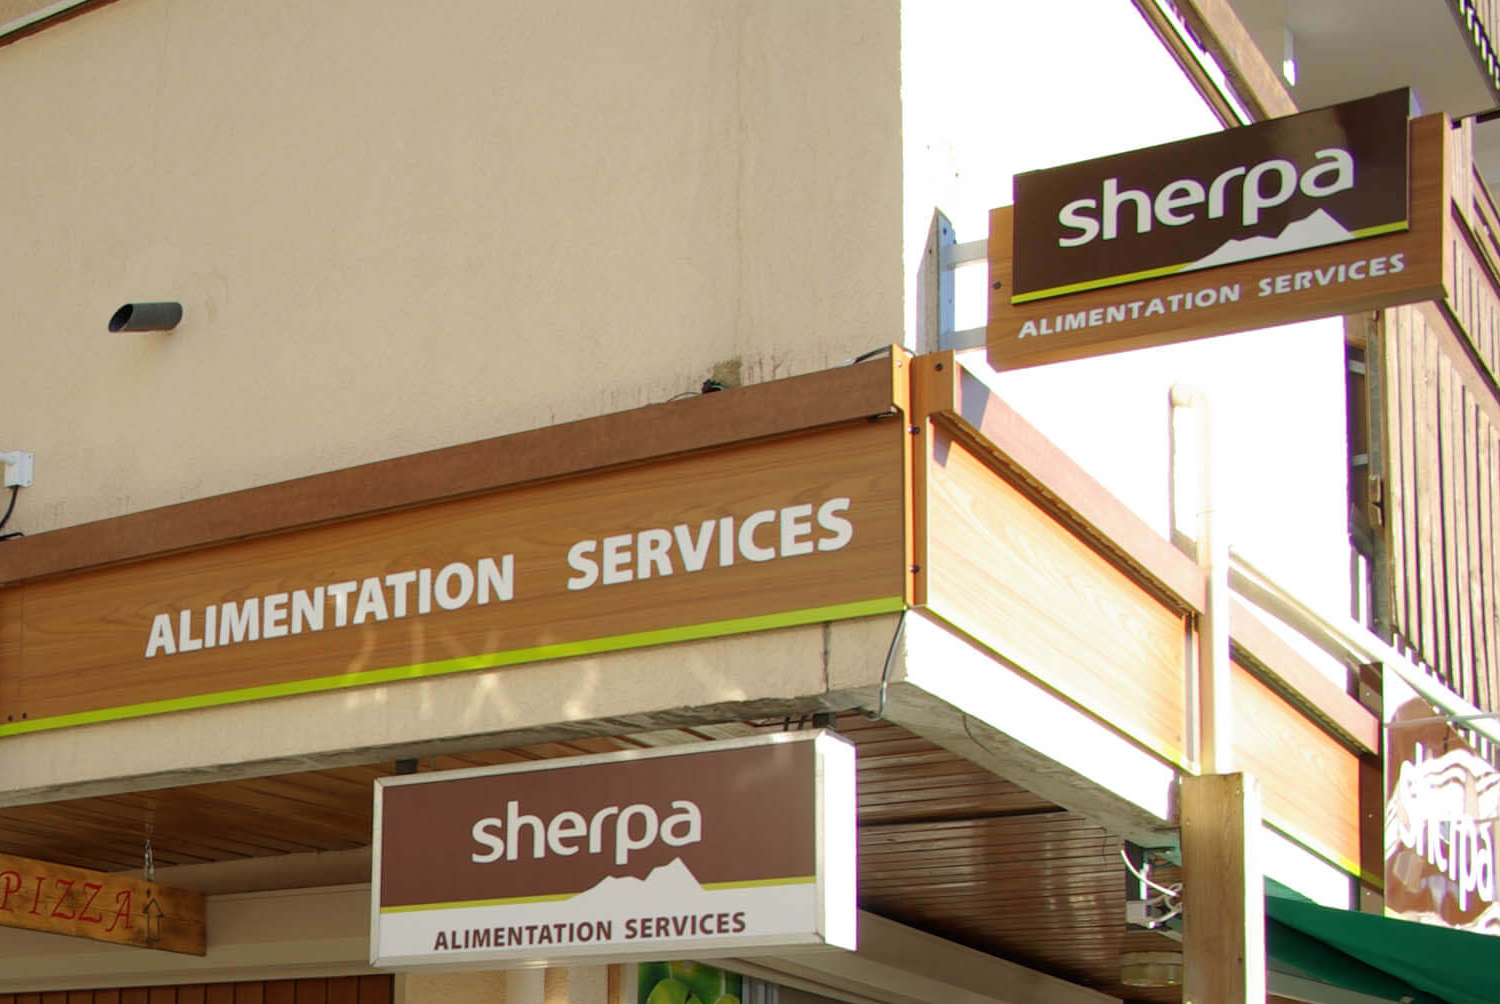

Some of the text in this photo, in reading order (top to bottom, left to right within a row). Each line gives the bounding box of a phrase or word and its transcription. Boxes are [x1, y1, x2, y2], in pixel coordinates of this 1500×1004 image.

[1057, 147, 1355, 248] sherpa
[1017, 252, 1406, 339] ALIMENTATION SERVICES
[144, 496, 854, 659] ALIMENTATION SERVICES
[471, 799, 702, 865] sherpa
[433, 911, 747, 951] ALIMENTATION SERVICES
